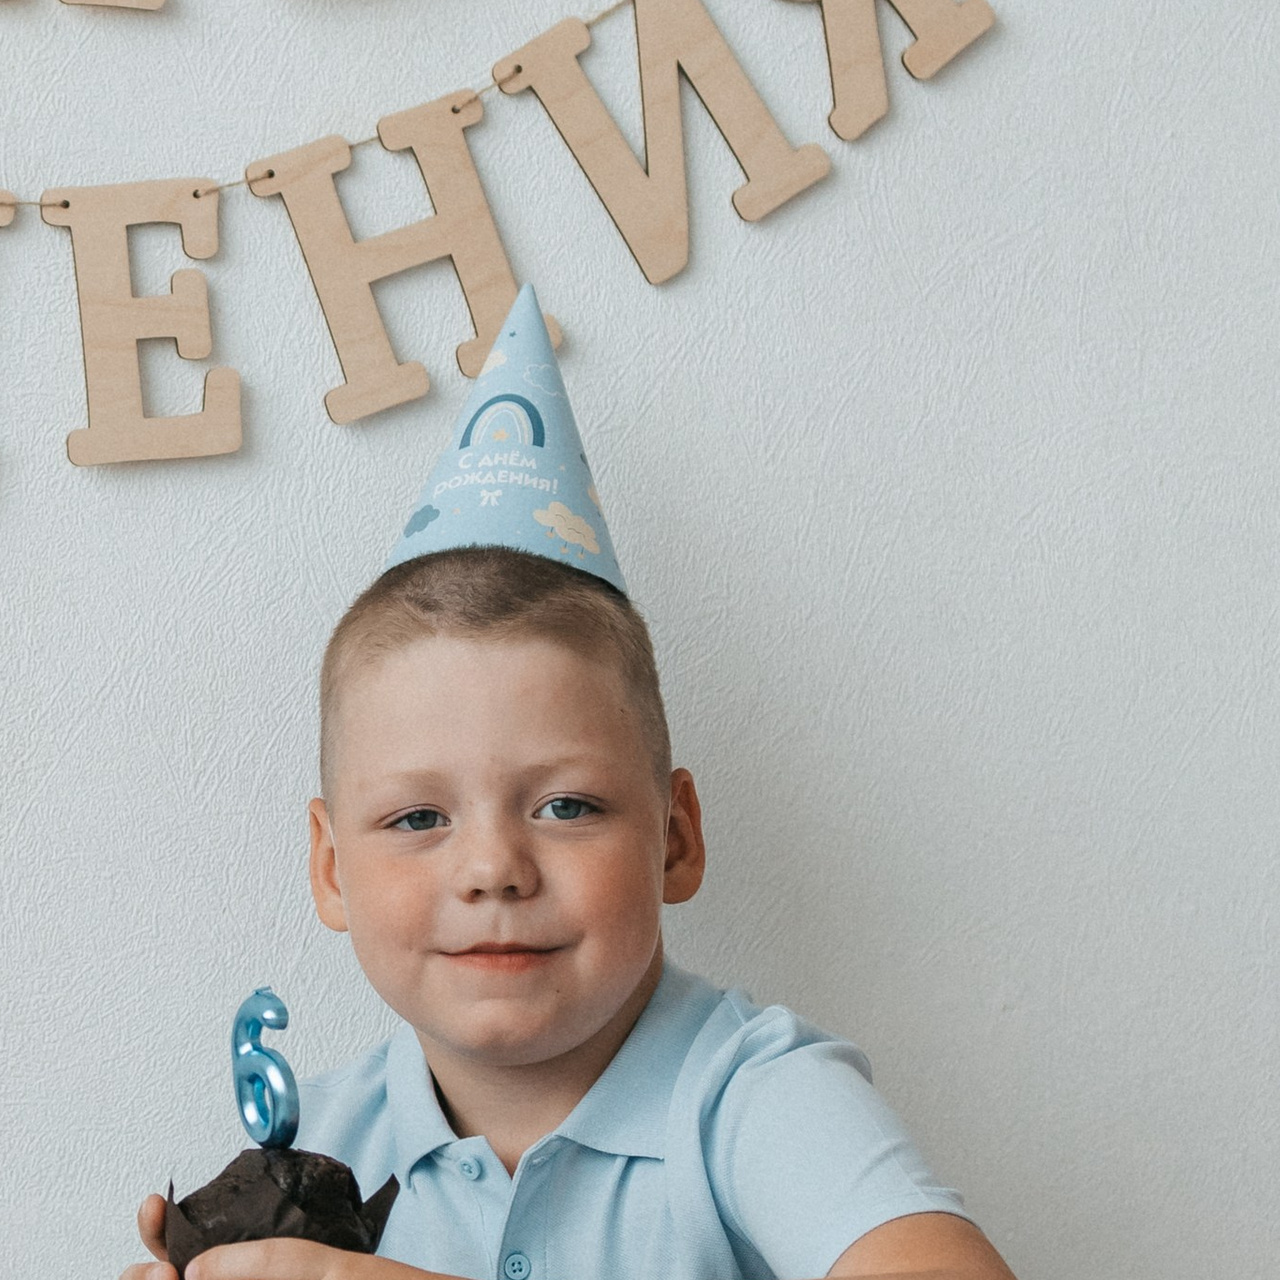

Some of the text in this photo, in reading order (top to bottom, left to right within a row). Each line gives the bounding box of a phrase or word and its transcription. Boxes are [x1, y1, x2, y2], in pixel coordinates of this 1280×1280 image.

[458, 450, 537, 469] С ДНЁМ
[433, 470, 558, 498] РОЖДЕНИЯ!
[231, 986, 300, 1149] 6
